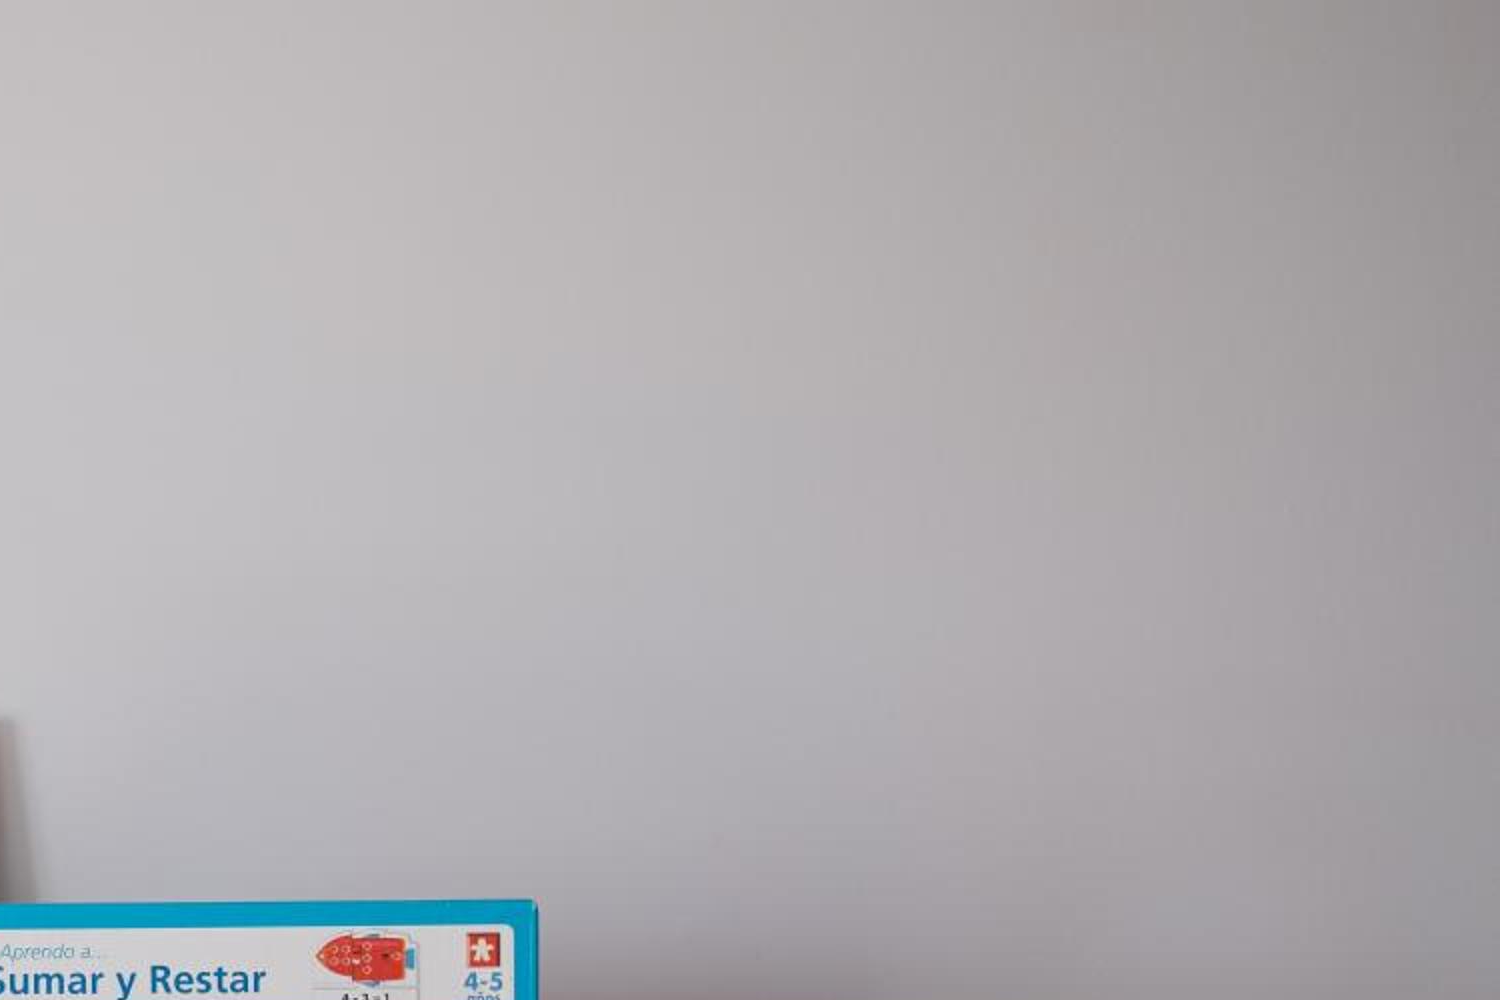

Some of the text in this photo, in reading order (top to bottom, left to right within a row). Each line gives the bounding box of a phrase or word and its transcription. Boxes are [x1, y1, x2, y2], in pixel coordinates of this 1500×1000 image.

[0, 943, 75, 962] Aprendo
[150, 963, 267, 994] Restar
[464, 972, 504, 991] 4-5
